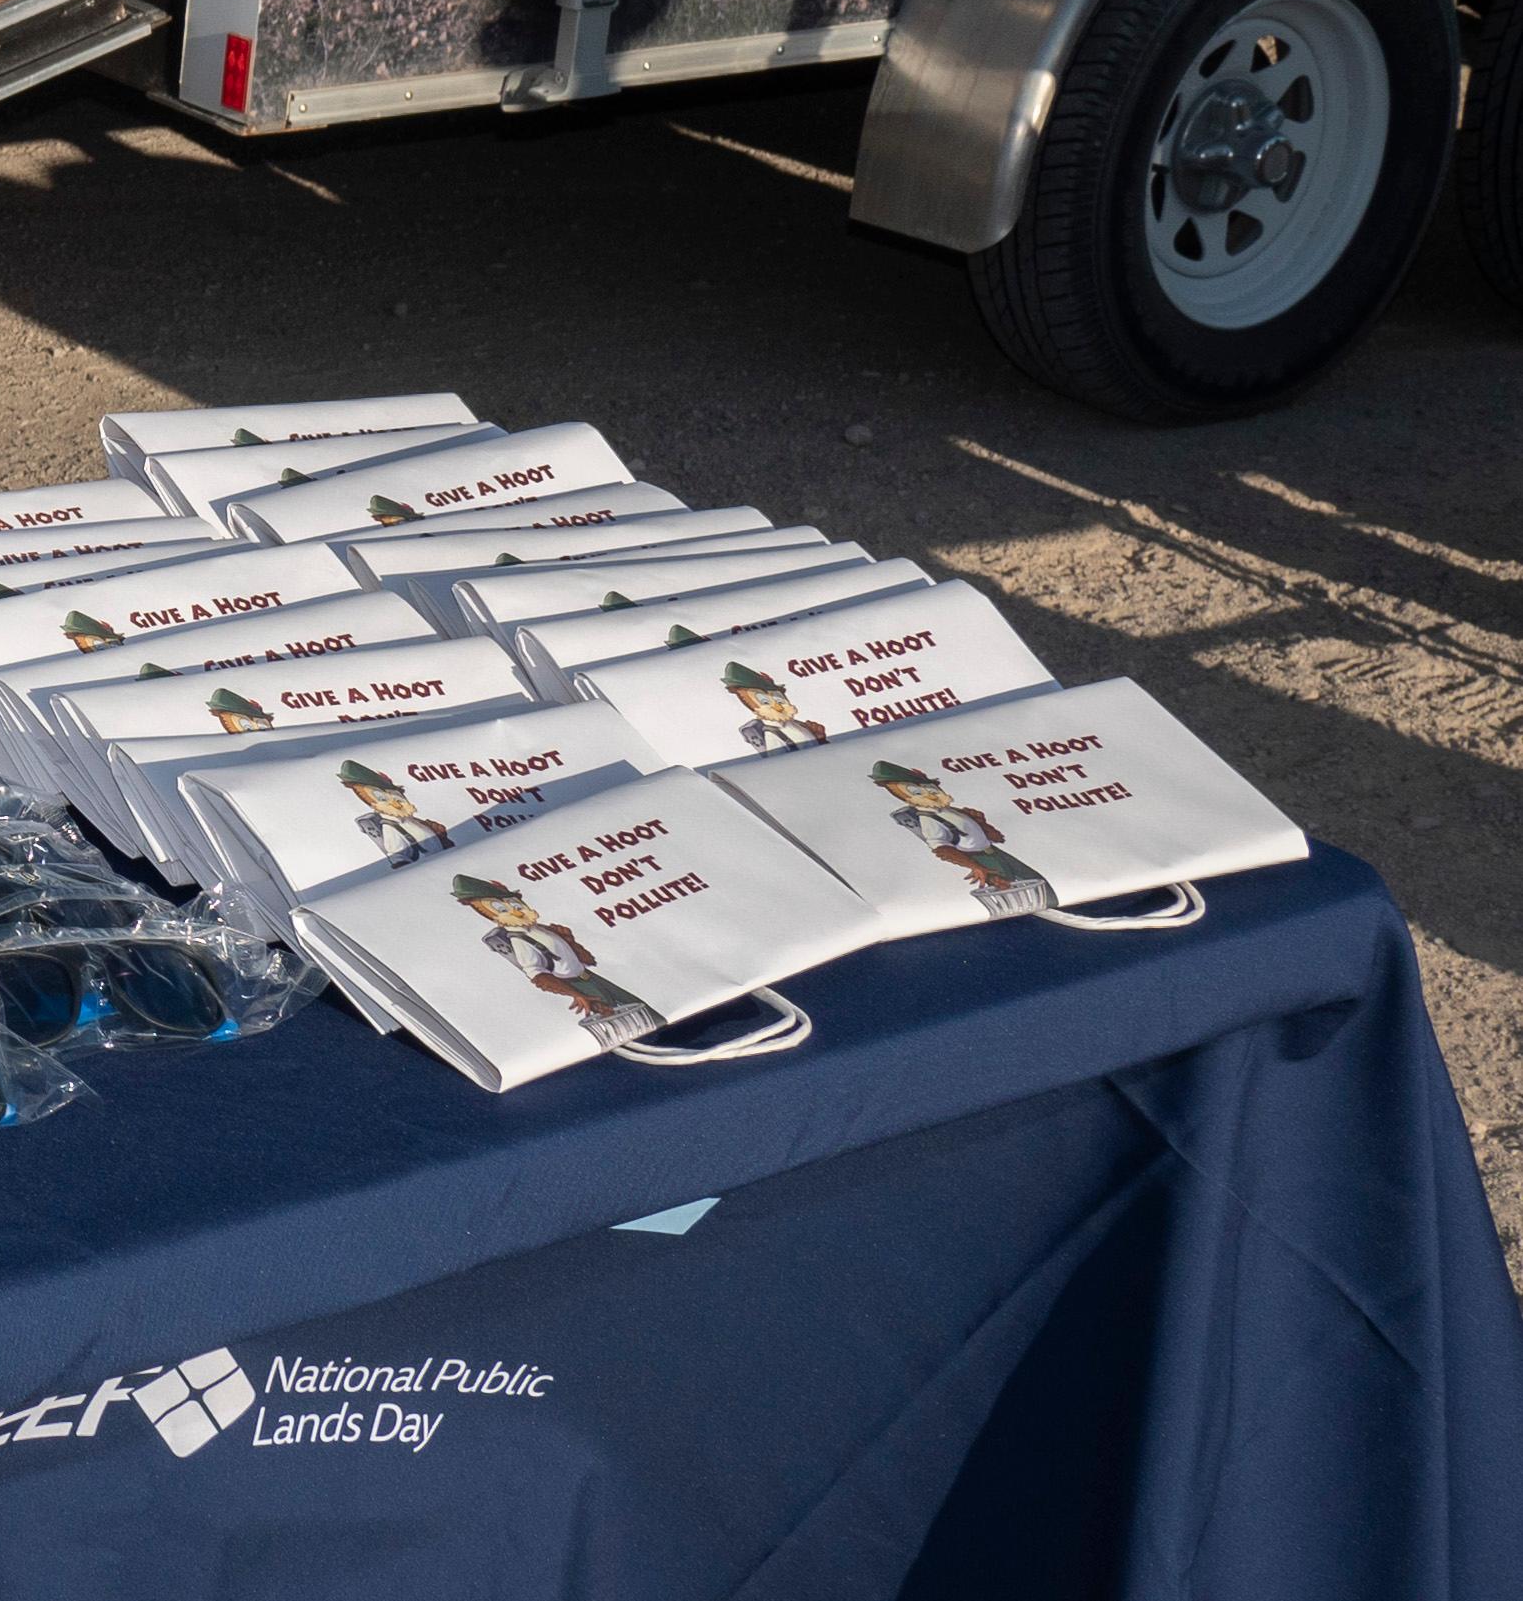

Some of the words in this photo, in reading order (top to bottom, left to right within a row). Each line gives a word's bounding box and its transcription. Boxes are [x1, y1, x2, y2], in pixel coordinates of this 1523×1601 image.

[425, 485, 474, 507] GIVE
[476, 481, 496, 497] A
[493, 464, 555, 490] HOOT
[15, 507, 85, 528] HOOT
[130, 608, 185, 629] GIVE
[192, 604, 212, 620] A
[213, 591, 284, 614] HOOT
[286, 634, 357, 658] HOOT
[788, 653, 844, 678] GIVE
[846, 649, 869, 666] A
[865, 630, 936, 660] HOOT
[281, 688, 341, 709] GIVE
[348, 687, 370, 703] A
[370, 680, 446, 701] HOOT
[844, 666, 921, 698] DON'T
[851, 688, 962, 729] POLLUTE!
[407, 763, 466, 782] GIVE
[469, 761, 492, 778] A
[489, 750, 564, 776] HOOT
[941, 752, 1002, 773] GIVE
[1005, 749, 1030, 764] A
[1026, 735, 1103, 759] HOOT
[466, 786, 545, 805] DON'T
[1003, 764, 1088, 790] DON'T
[1012, 782, 1133, 815] POLLUTE!
[517, 853, 577, 882] GIVE
[577, 845, 603, 863] A
[594, 819, 669, 853] HOOT
[580, 855, 662, 895] DON'T
[594, 872, 710, 928] POLLUTE!
[264, 1355, 432, 1395] National
[431, 1360, 555, 1399] Public
[253, 1405, 366, 1447] Lands
[370, 1410, 444, 1453] Day
